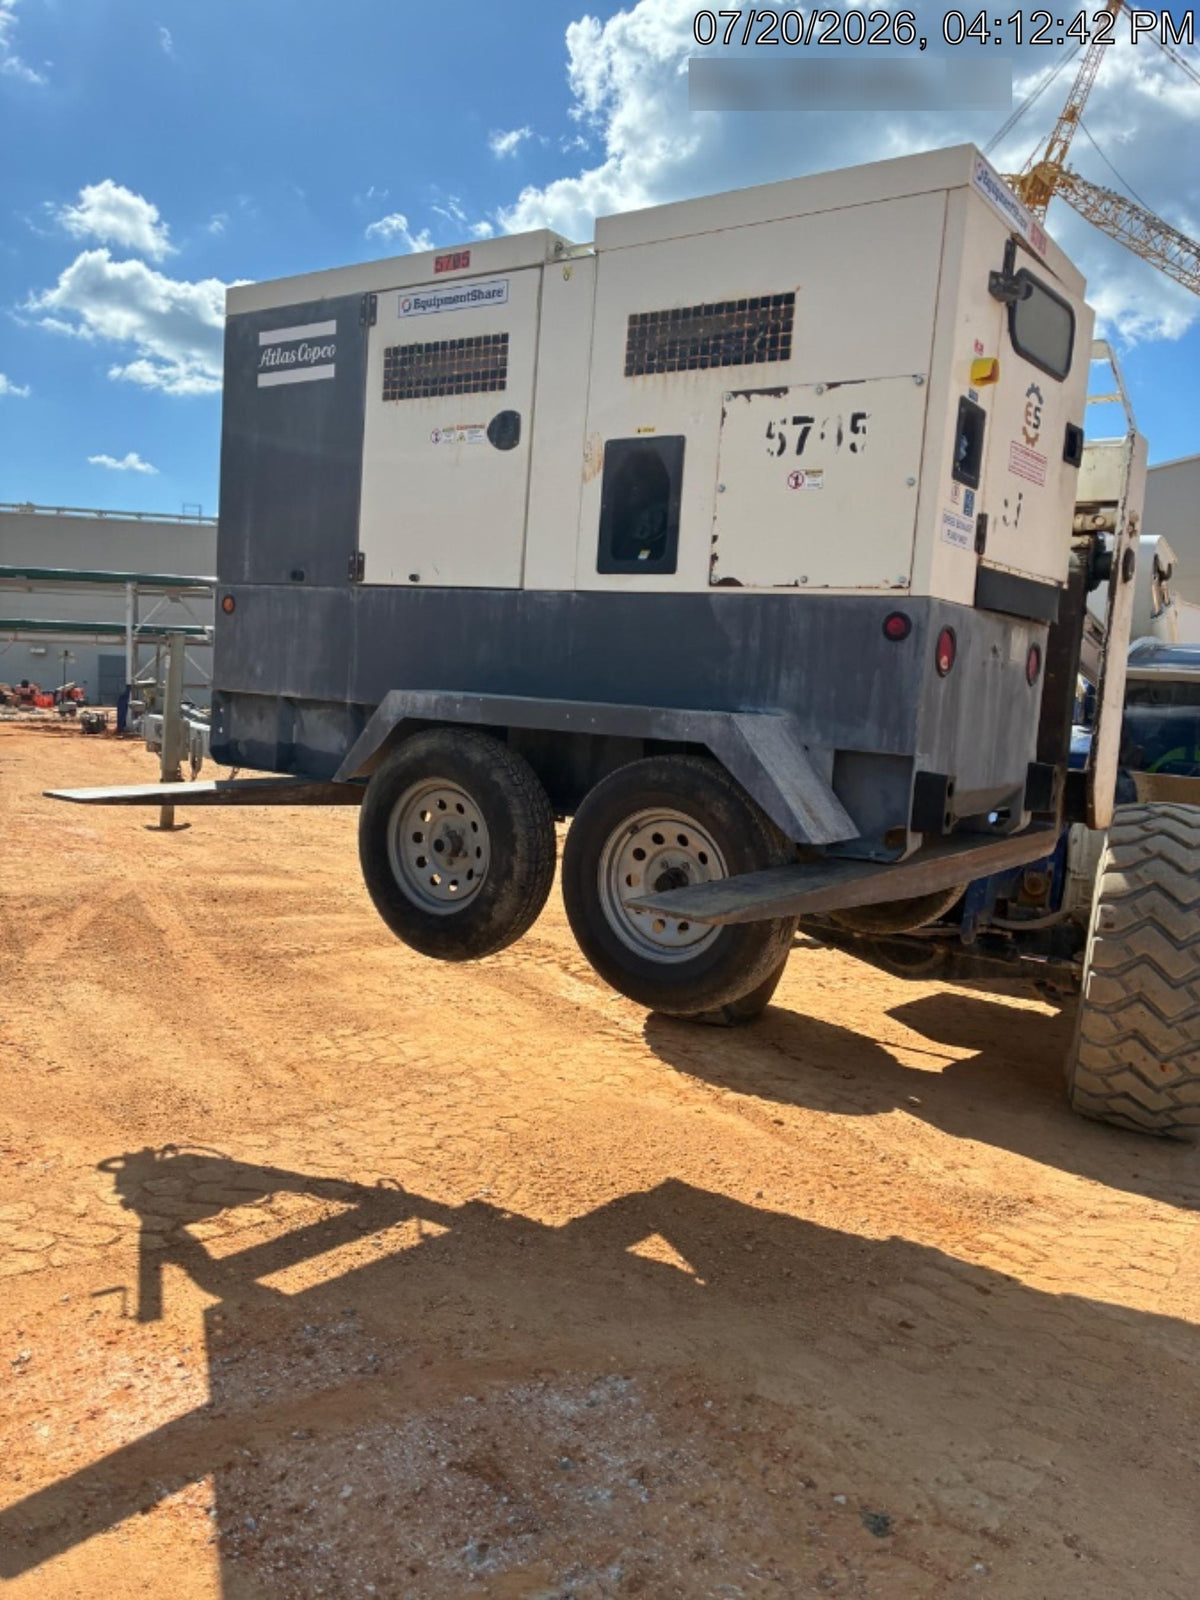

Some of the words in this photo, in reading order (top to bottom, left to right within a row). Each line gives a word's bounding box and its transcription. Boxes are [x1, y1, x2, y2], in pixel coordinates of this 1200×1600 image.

[413, 287, 504, 311] EquipmentShare
[257, 347, 296, 368] Atlas
[298, 342, 337, 364] Copco
